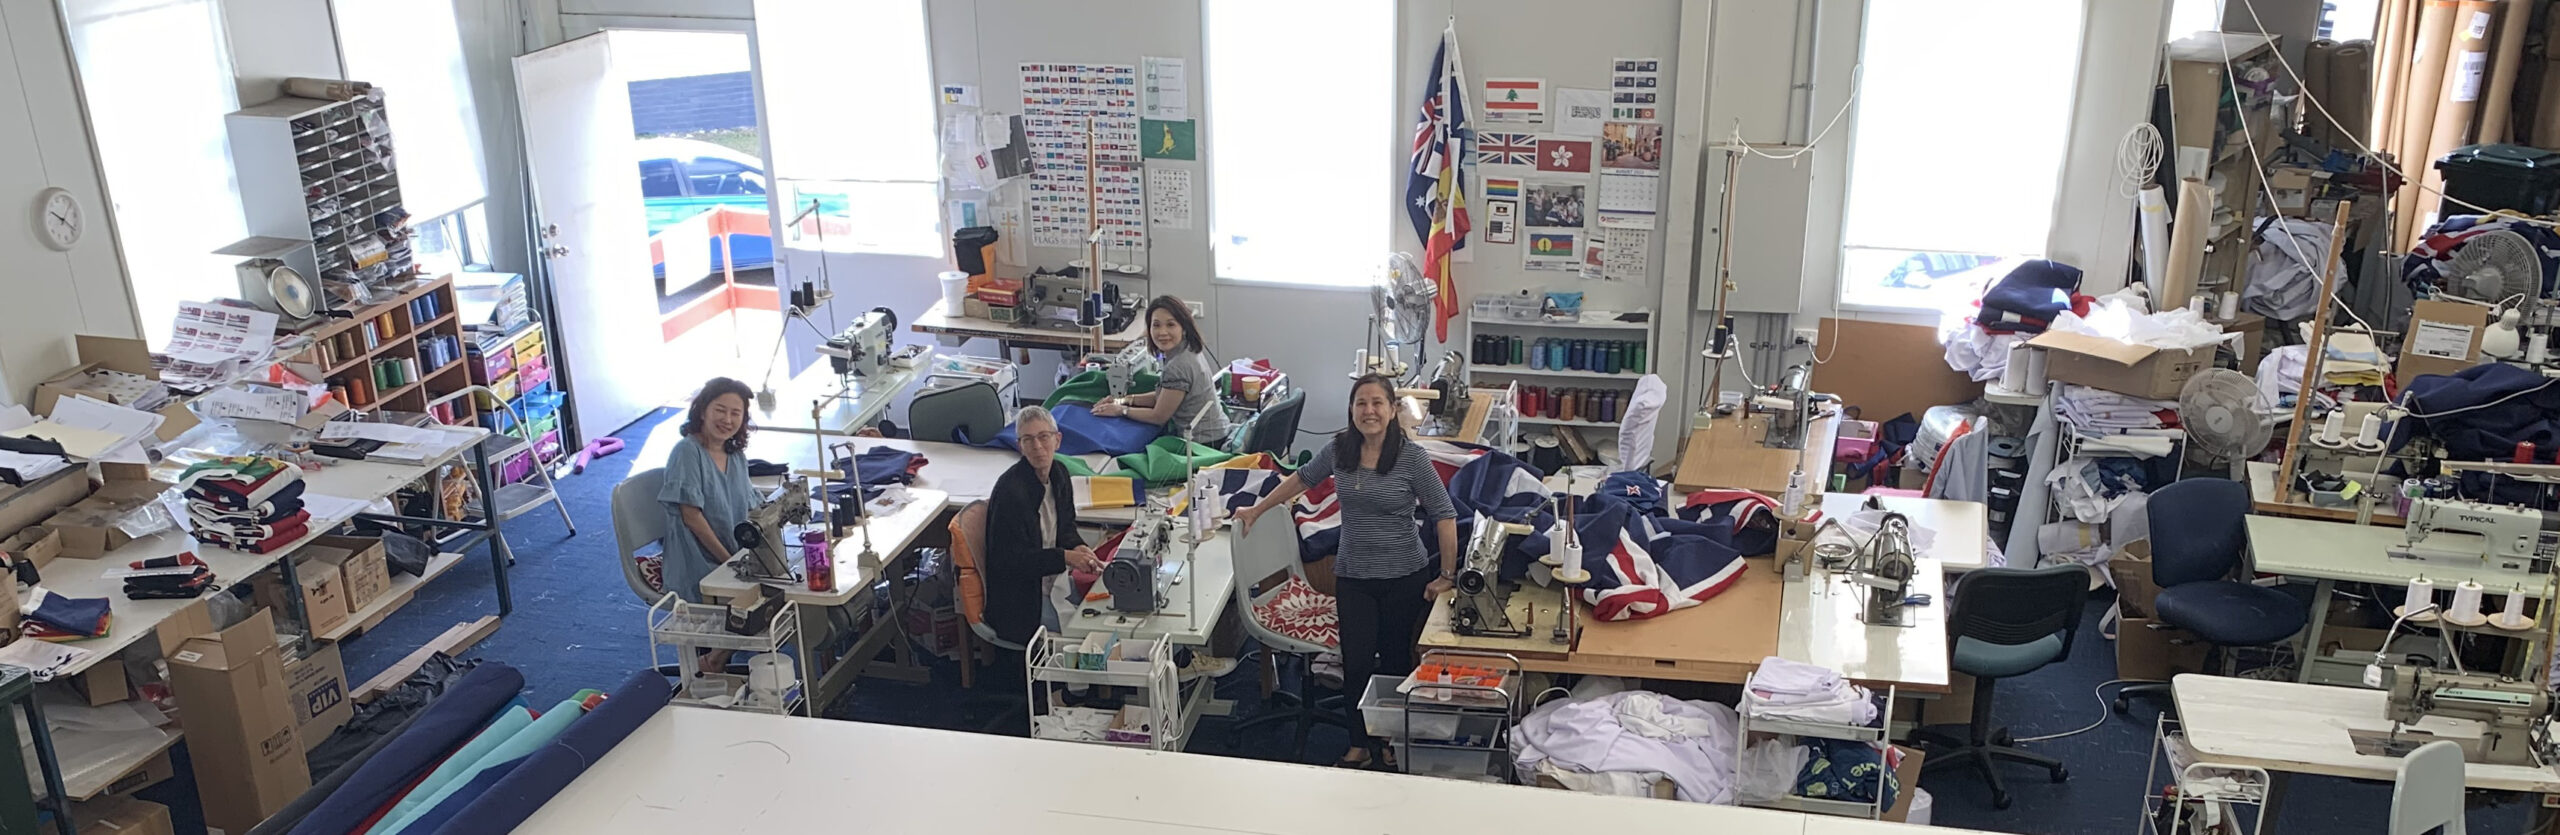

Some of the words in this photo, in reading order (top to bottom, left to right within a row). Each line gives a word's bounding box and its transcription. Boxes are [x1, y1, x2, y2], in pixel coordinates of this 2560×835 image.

[1034, 236, 1059, 245] FLAGS
[2459, 514, 2496, 524] TYPICAL
[312, 687, 340, 713] VIP
